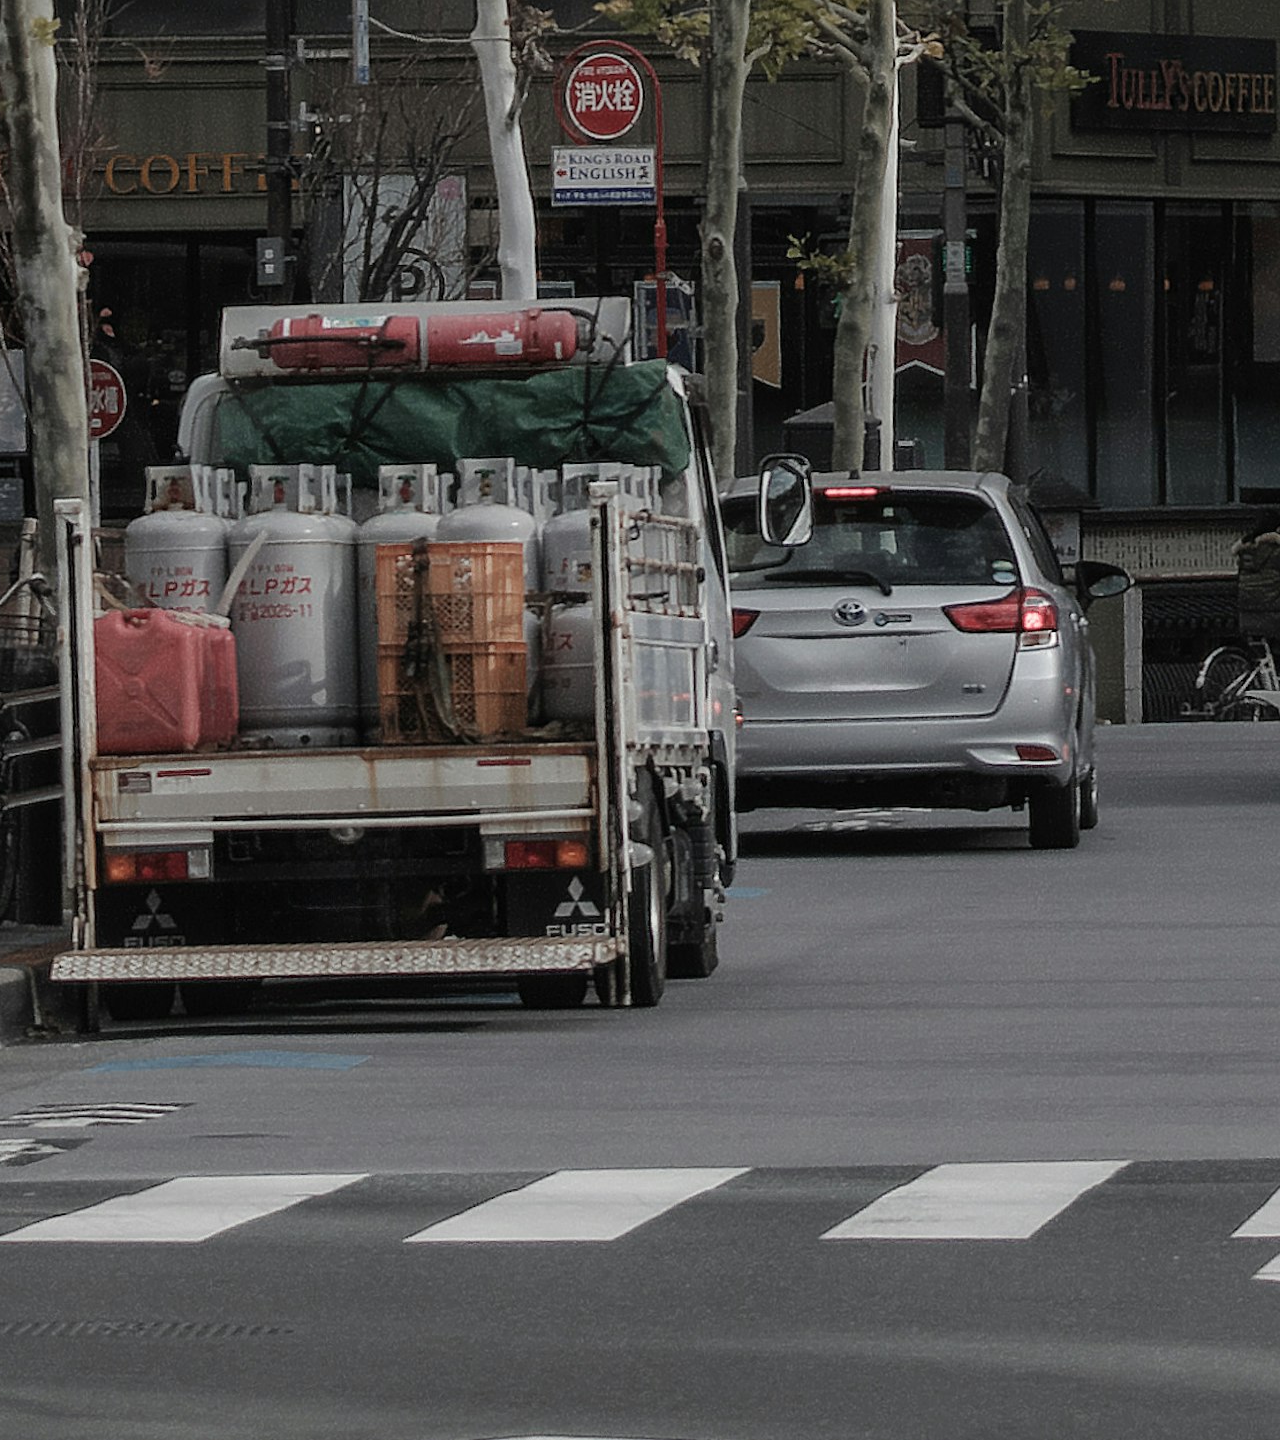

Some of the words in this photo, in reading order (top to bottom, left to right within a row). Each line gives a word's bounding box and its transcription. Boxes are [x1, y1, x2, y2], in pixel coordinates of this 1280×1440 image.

[574, 78, 636, 113] 消火栓
[1193, 70, 1275, 114] COFFEE
[569, 152, 611, 165] KING'S
[614, 152, 651, 165] ROAD
[104, 151, 308, 195] COFF
[570, 167, 636, 180] ENGLISH
[545, 923, 610, 937] FUSO
